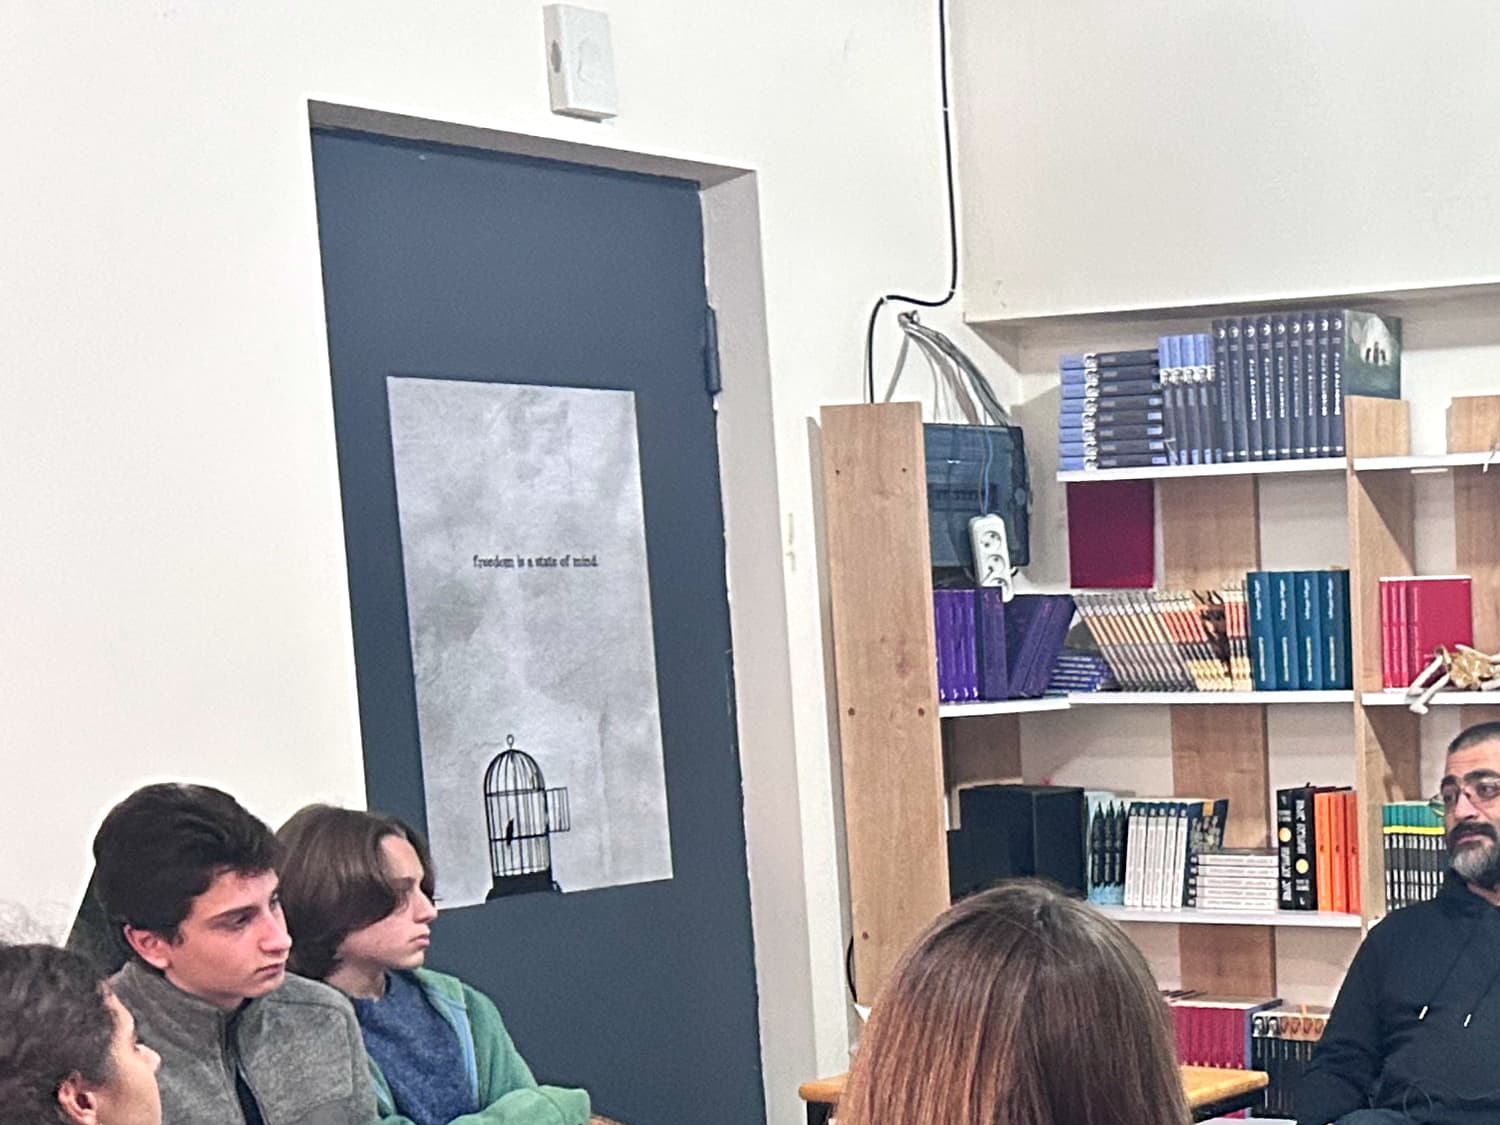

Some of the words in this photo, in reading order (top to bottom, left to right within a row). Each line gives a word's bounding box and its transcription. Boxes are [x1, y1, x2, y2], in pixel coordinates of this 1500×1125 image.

[473, 554, 515, 568] freedom
[535, 556, 558, 568] state
[560, 554, 571, 568] of
